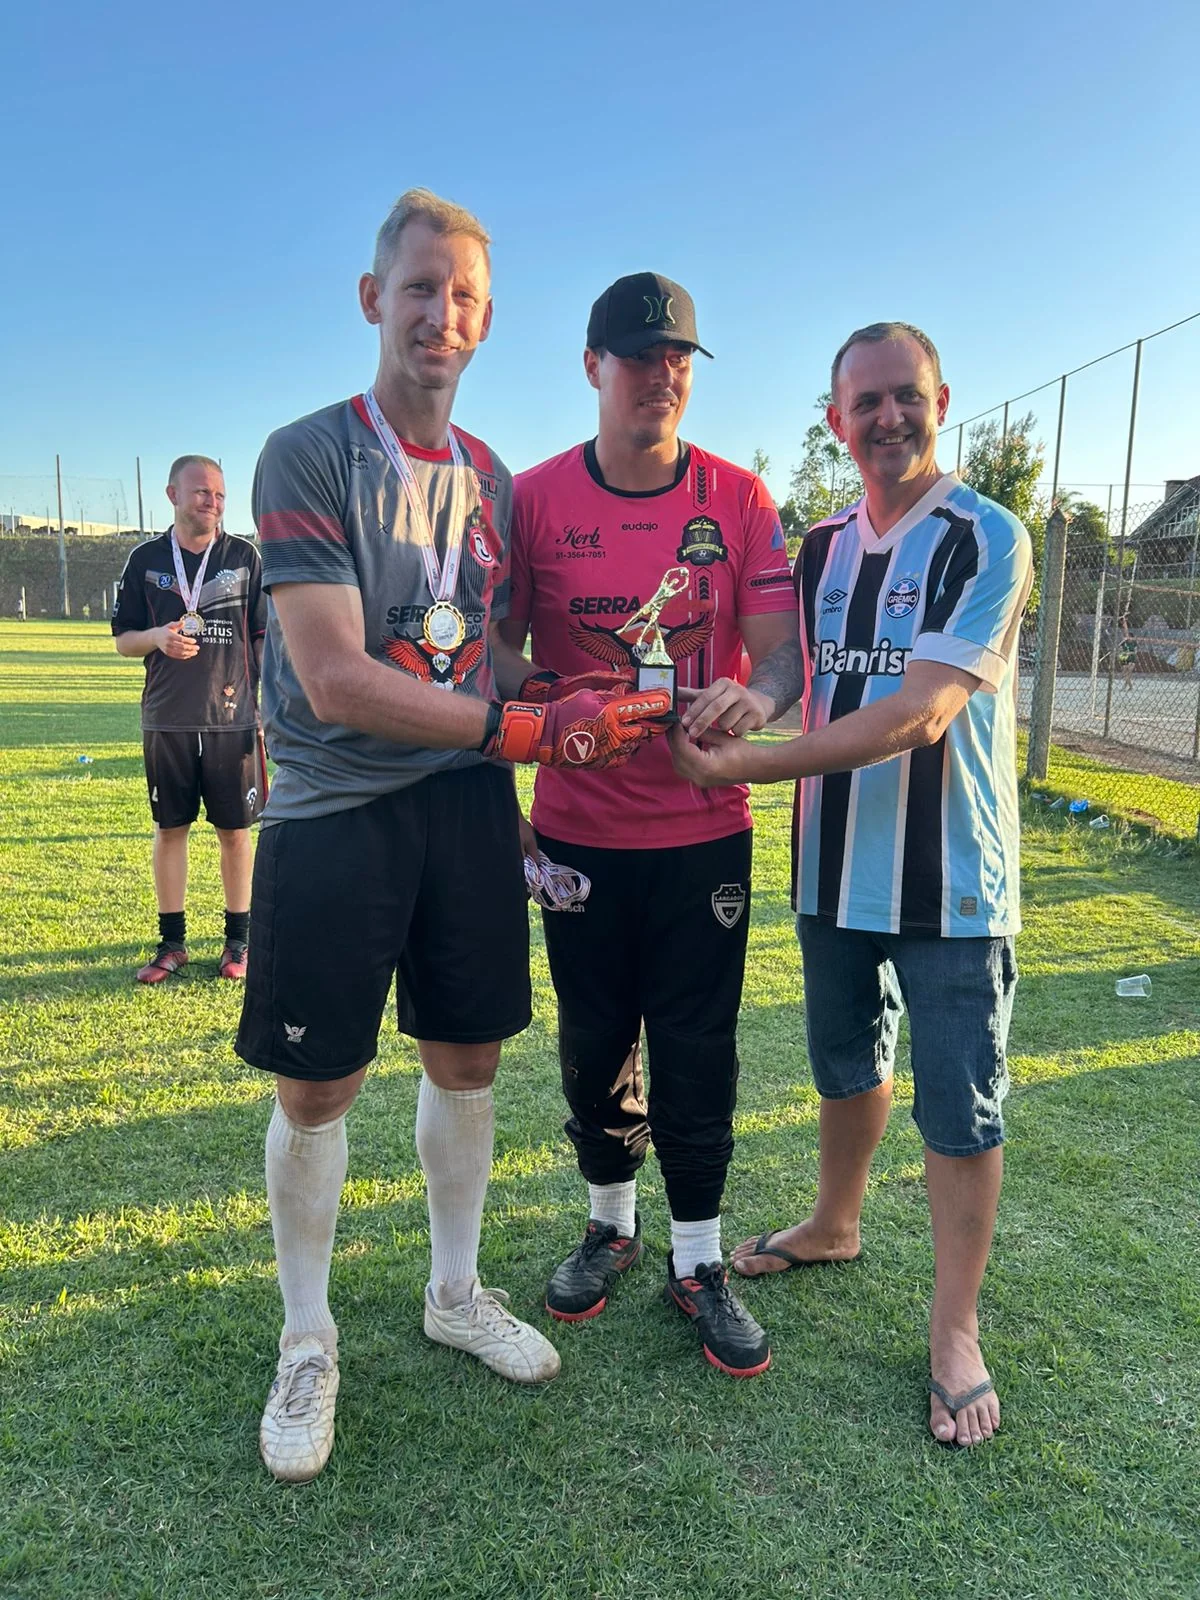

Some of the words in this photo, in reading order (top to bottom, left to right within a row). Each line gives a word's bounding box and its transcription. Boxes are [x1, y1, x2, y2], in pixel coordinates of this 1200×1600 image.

[621, 522, 659, 532] eudajo
[555, 525, 604, 549] Korb
[555, 551, 606, 559] 51-3564-7051
[569, 596, 641, 615] SERRA
[823, 605, 843, 615] umbro
